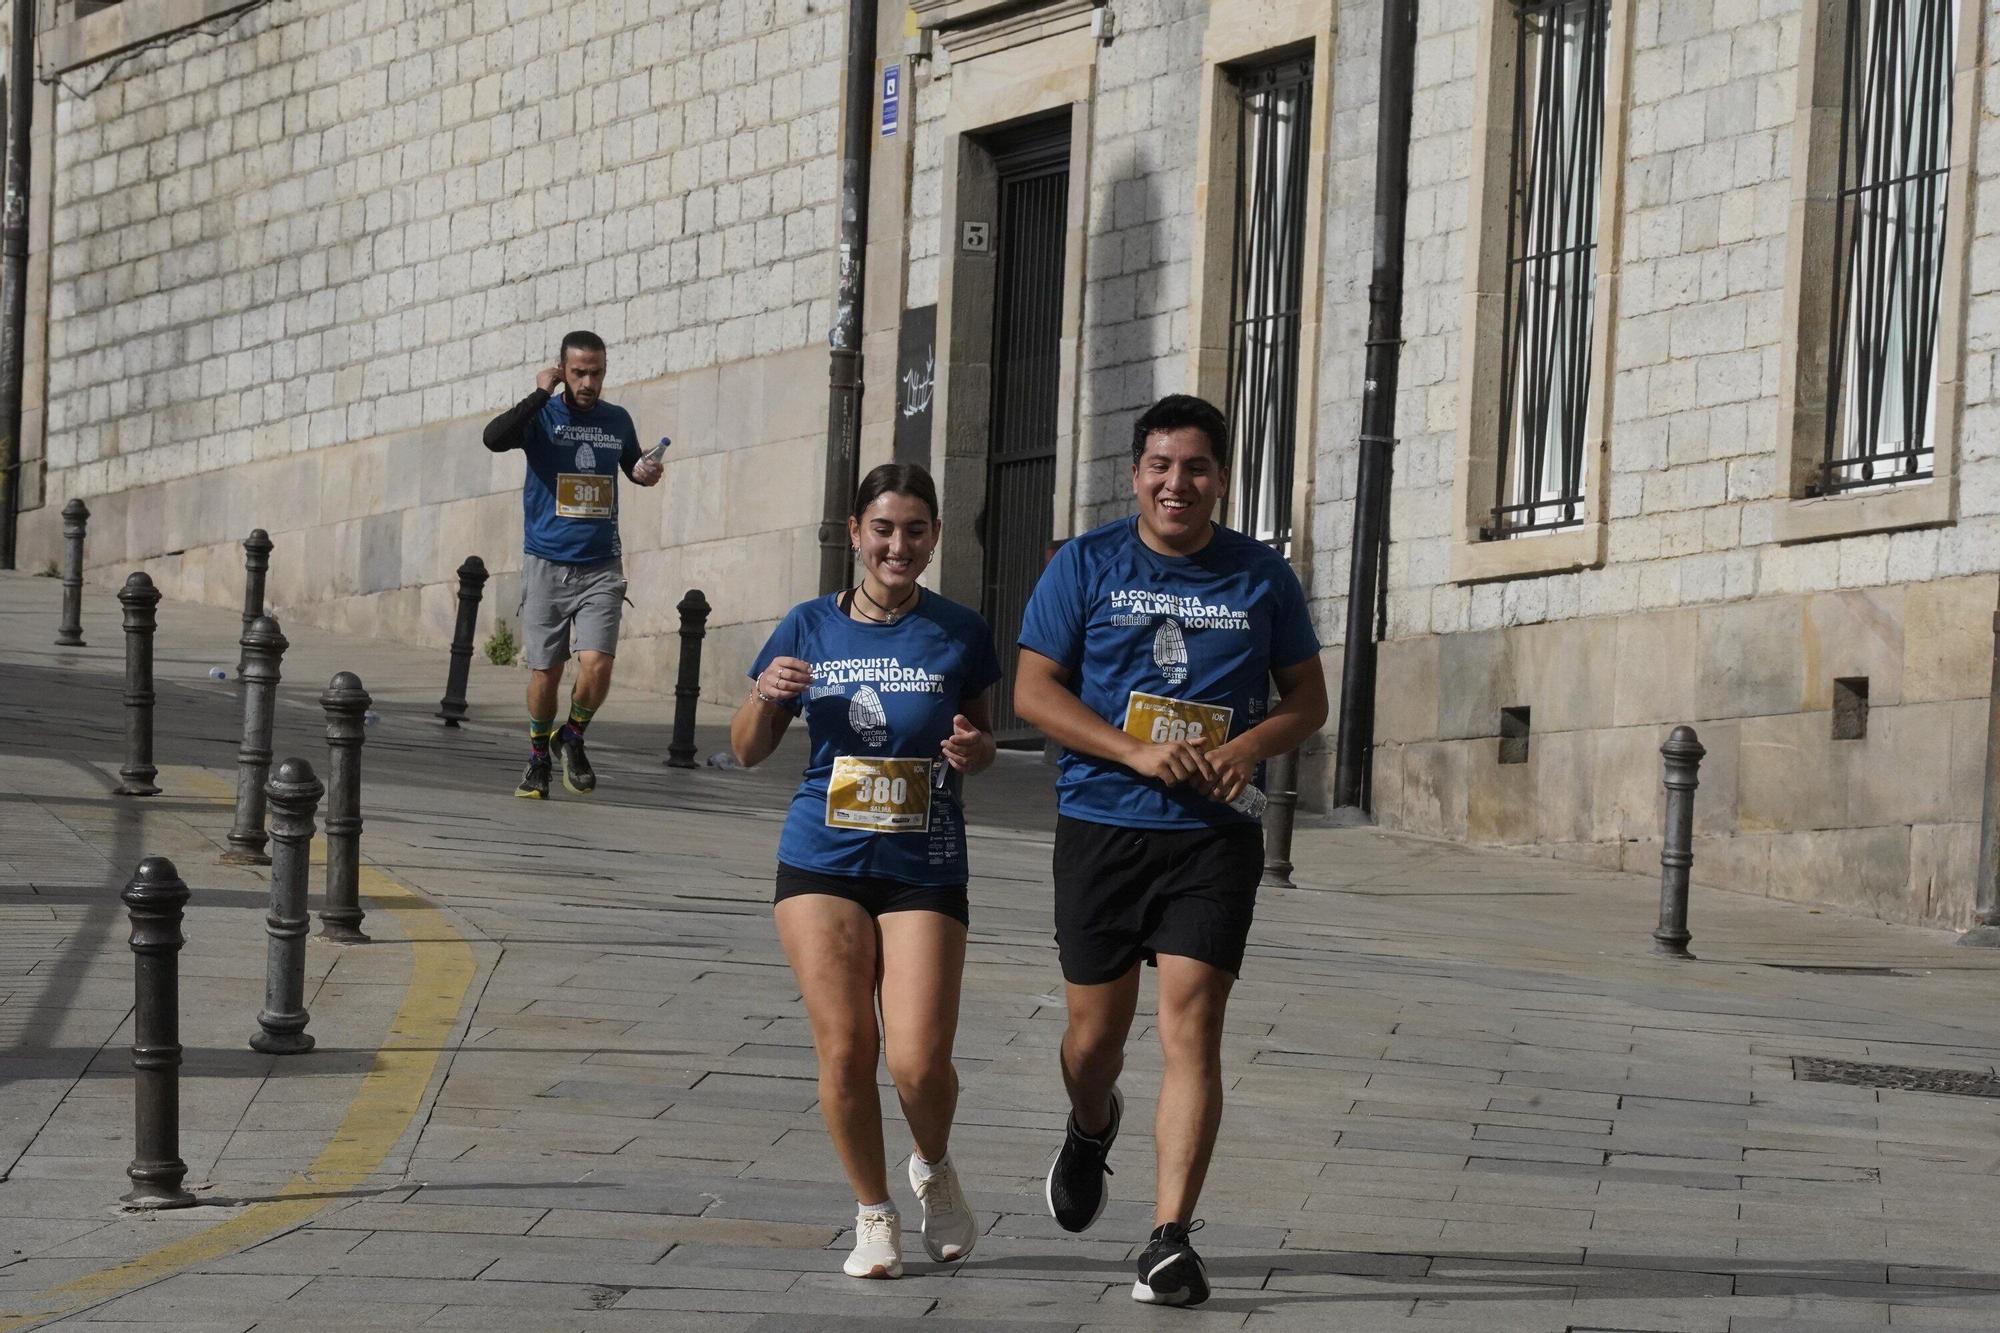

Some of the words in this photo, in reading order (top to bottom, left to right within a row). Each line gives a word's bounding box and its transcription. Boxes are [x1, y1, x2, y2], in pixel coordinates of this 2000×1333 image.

[561, 425, 602, 433] CONQUISTA
[563, 432, 615, 442] ALMENDRA
[574, 485, 600, 502] 381
[1111, 591, 1127, 601] LA
[1128, 590, 1202, 606] CONQUISTA
[1132, 600, 1231, 618] ALMENDRA
[1185, 617, 1250, 630] KONKISTA
[823, 657, 900, 672] CONQUISTA
[827, 668, 928, 685] ALMENDRA
[880, 682, 944, 693] KONKISTA
[1212, 713, 1225, 722] 10K
[856, 776, 907, 805] 380
